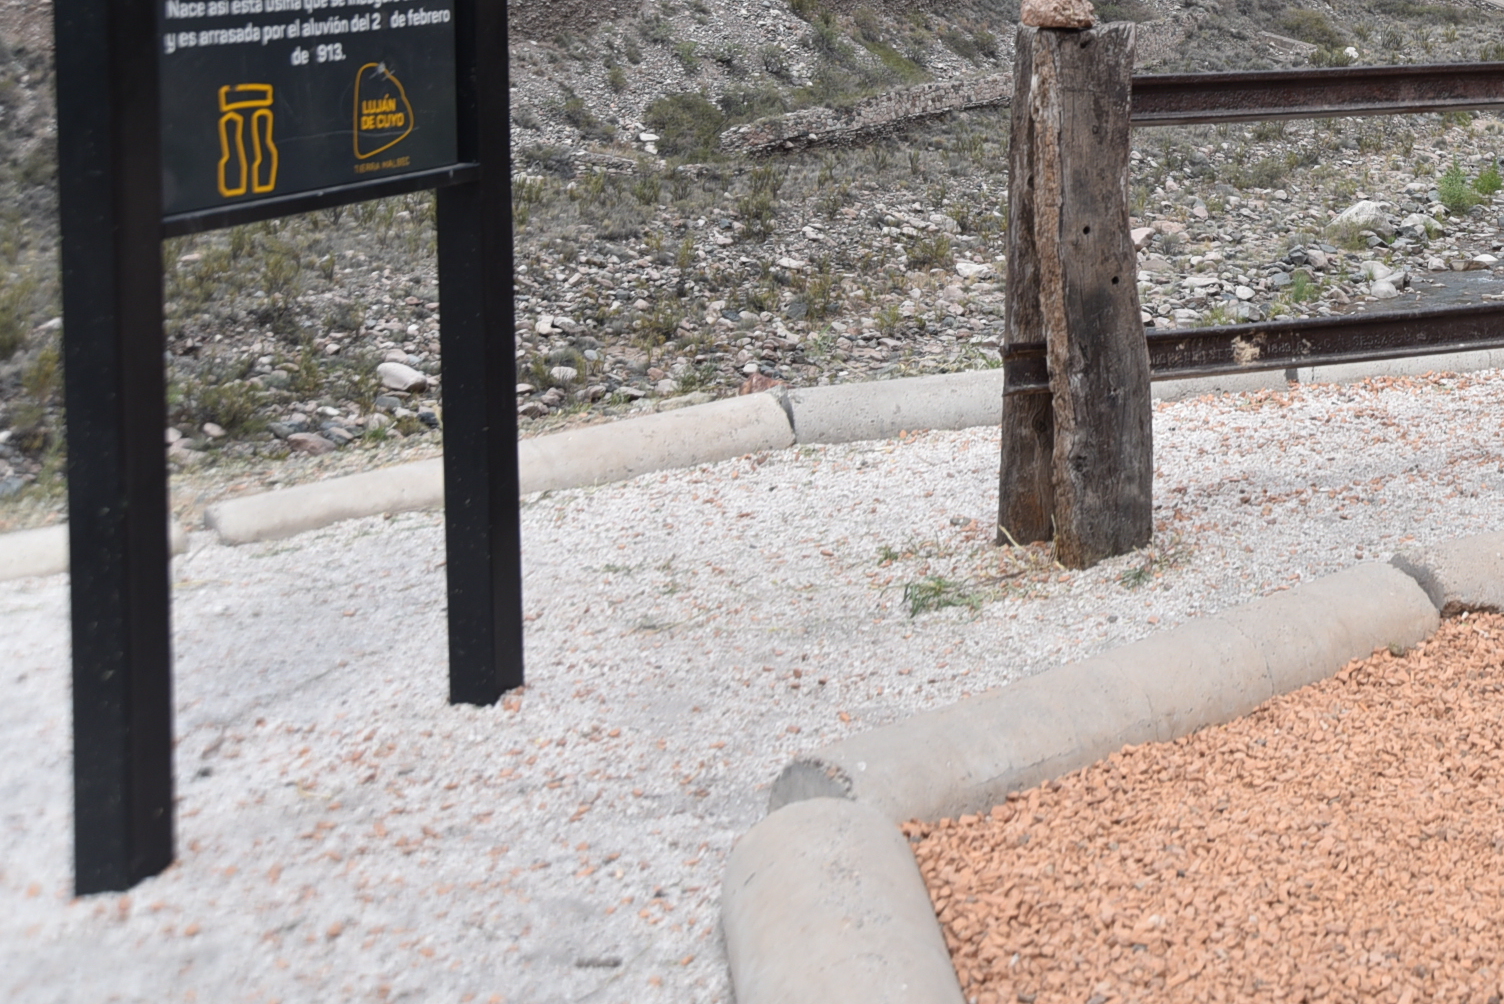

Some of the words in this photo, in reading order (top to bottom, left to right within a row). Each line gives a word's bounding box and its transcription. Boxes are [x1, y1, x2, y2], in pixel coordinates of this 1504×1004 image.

[164, 32, 177, 54] y
[177, 31, 197, 48] es
[197, 22, 261, 46] arrasada
[261, 24, 286, 46] por
[286, 18, 301, 38] el
[301, 15, 349, 37] aluvión
[350, 14, 370, 32] del
[390, 10, 406, 29] de
[406, 8, 451, 26] febrero
[290, 46, 310, 66] de
[361, 93, 397, 115] LUJÁN
[360, 114, 376, 130] DE
[376, 112, 405, 129] CUYO
